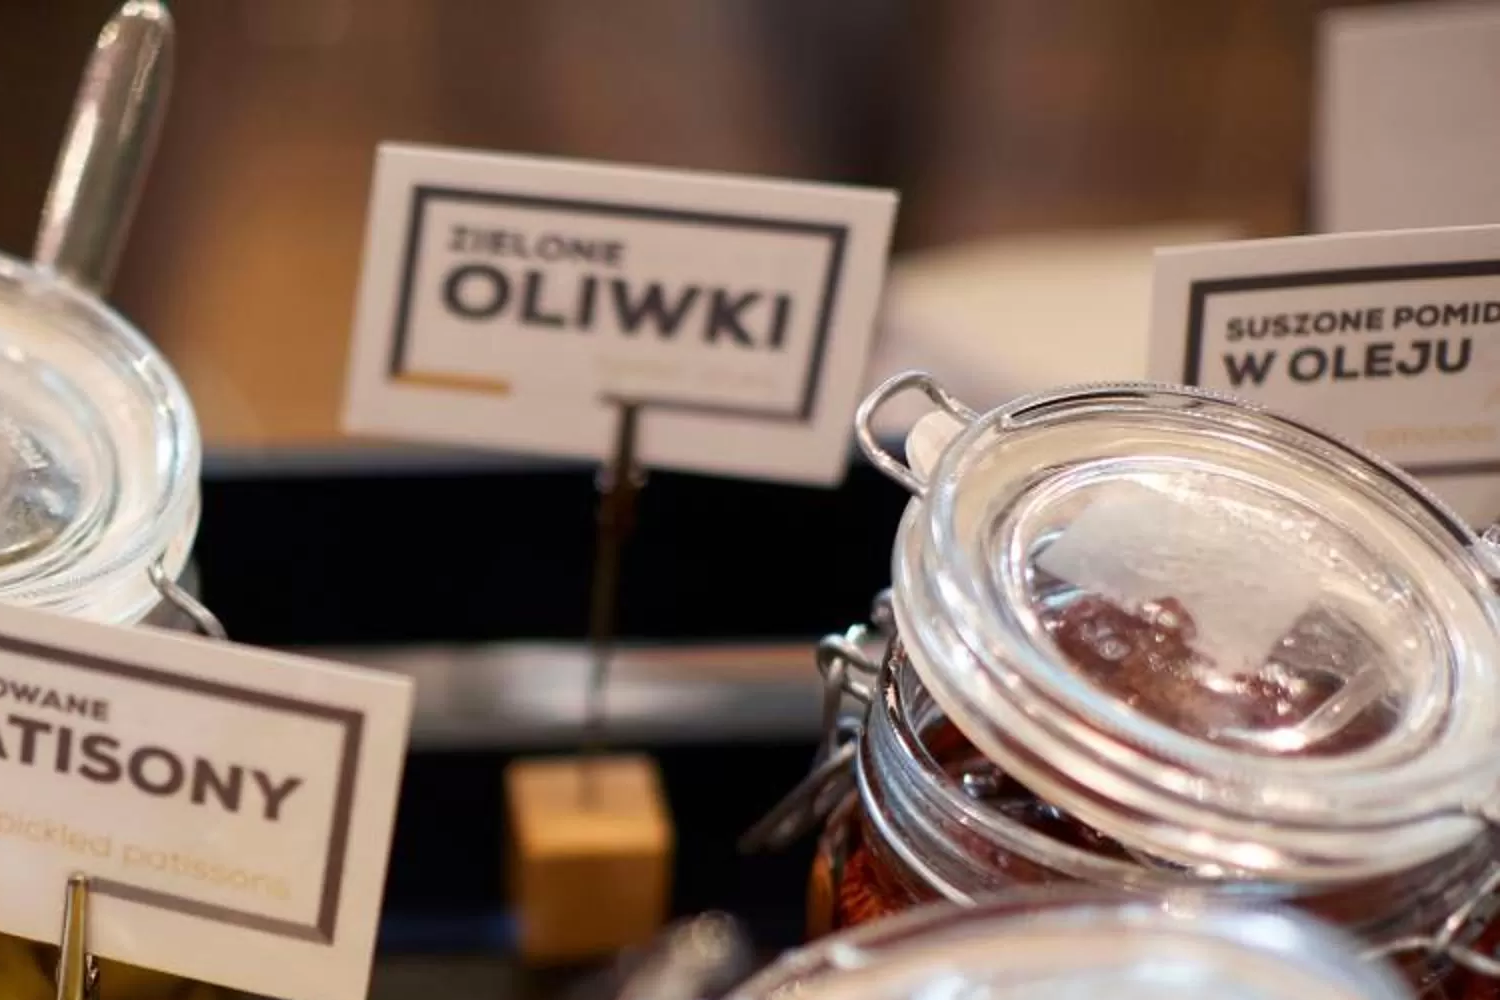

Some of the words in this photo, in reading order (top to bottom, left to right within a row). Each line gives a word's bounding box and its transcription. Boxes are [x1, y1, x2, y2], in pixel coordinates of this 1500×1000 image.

[446, 225, 626, 266] ZIELONE
[442, 263, 794, 350] OLIWKI
[1226, 307, 1385, 342] SUSZONE
[1223, 351, 1276, 388] W
[1288, 337, 1472, 383] OLEJU
